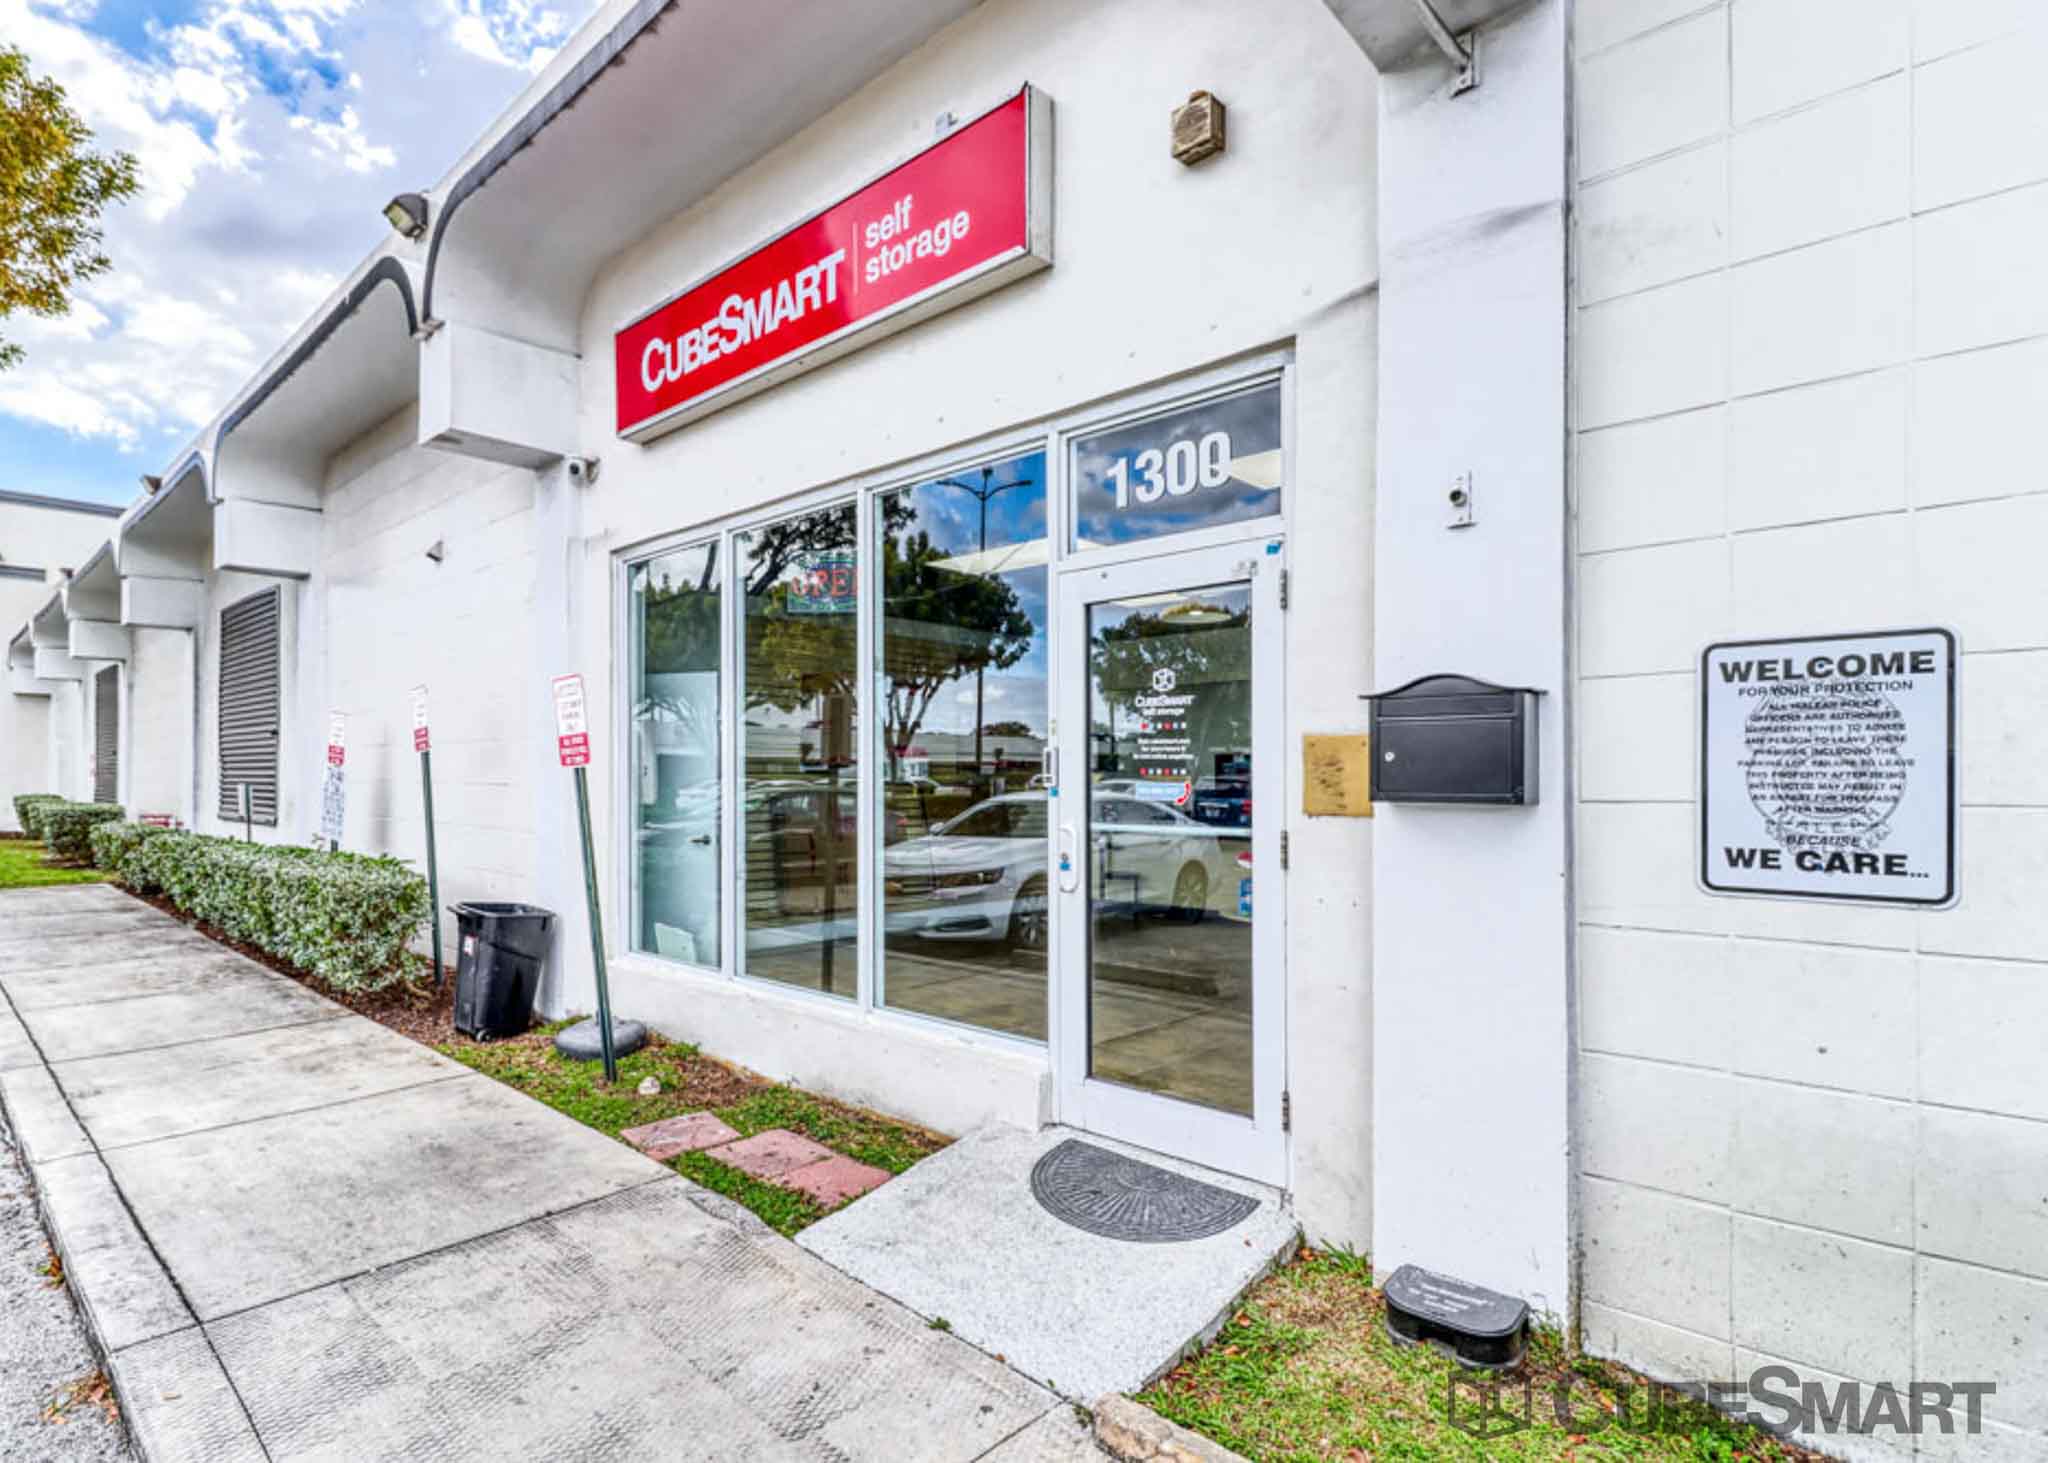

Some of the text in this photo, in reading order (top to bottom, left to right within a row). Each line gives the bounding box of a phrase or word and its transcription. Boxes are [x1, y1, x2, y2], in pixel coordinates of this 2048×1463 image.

[864, 193, 914, 248] self
[864, 209, 970, 283] storage
[1105, 431, 1232, 509] 1300
[1719, 650, 1936, 683] WELCOME
[1738, 681, 1913, 697] FOR YOUR PROTECTION
[1786, 834, 1861, 847] BECAUSE
[1724, 848, 1930, 878] WE CARE...
